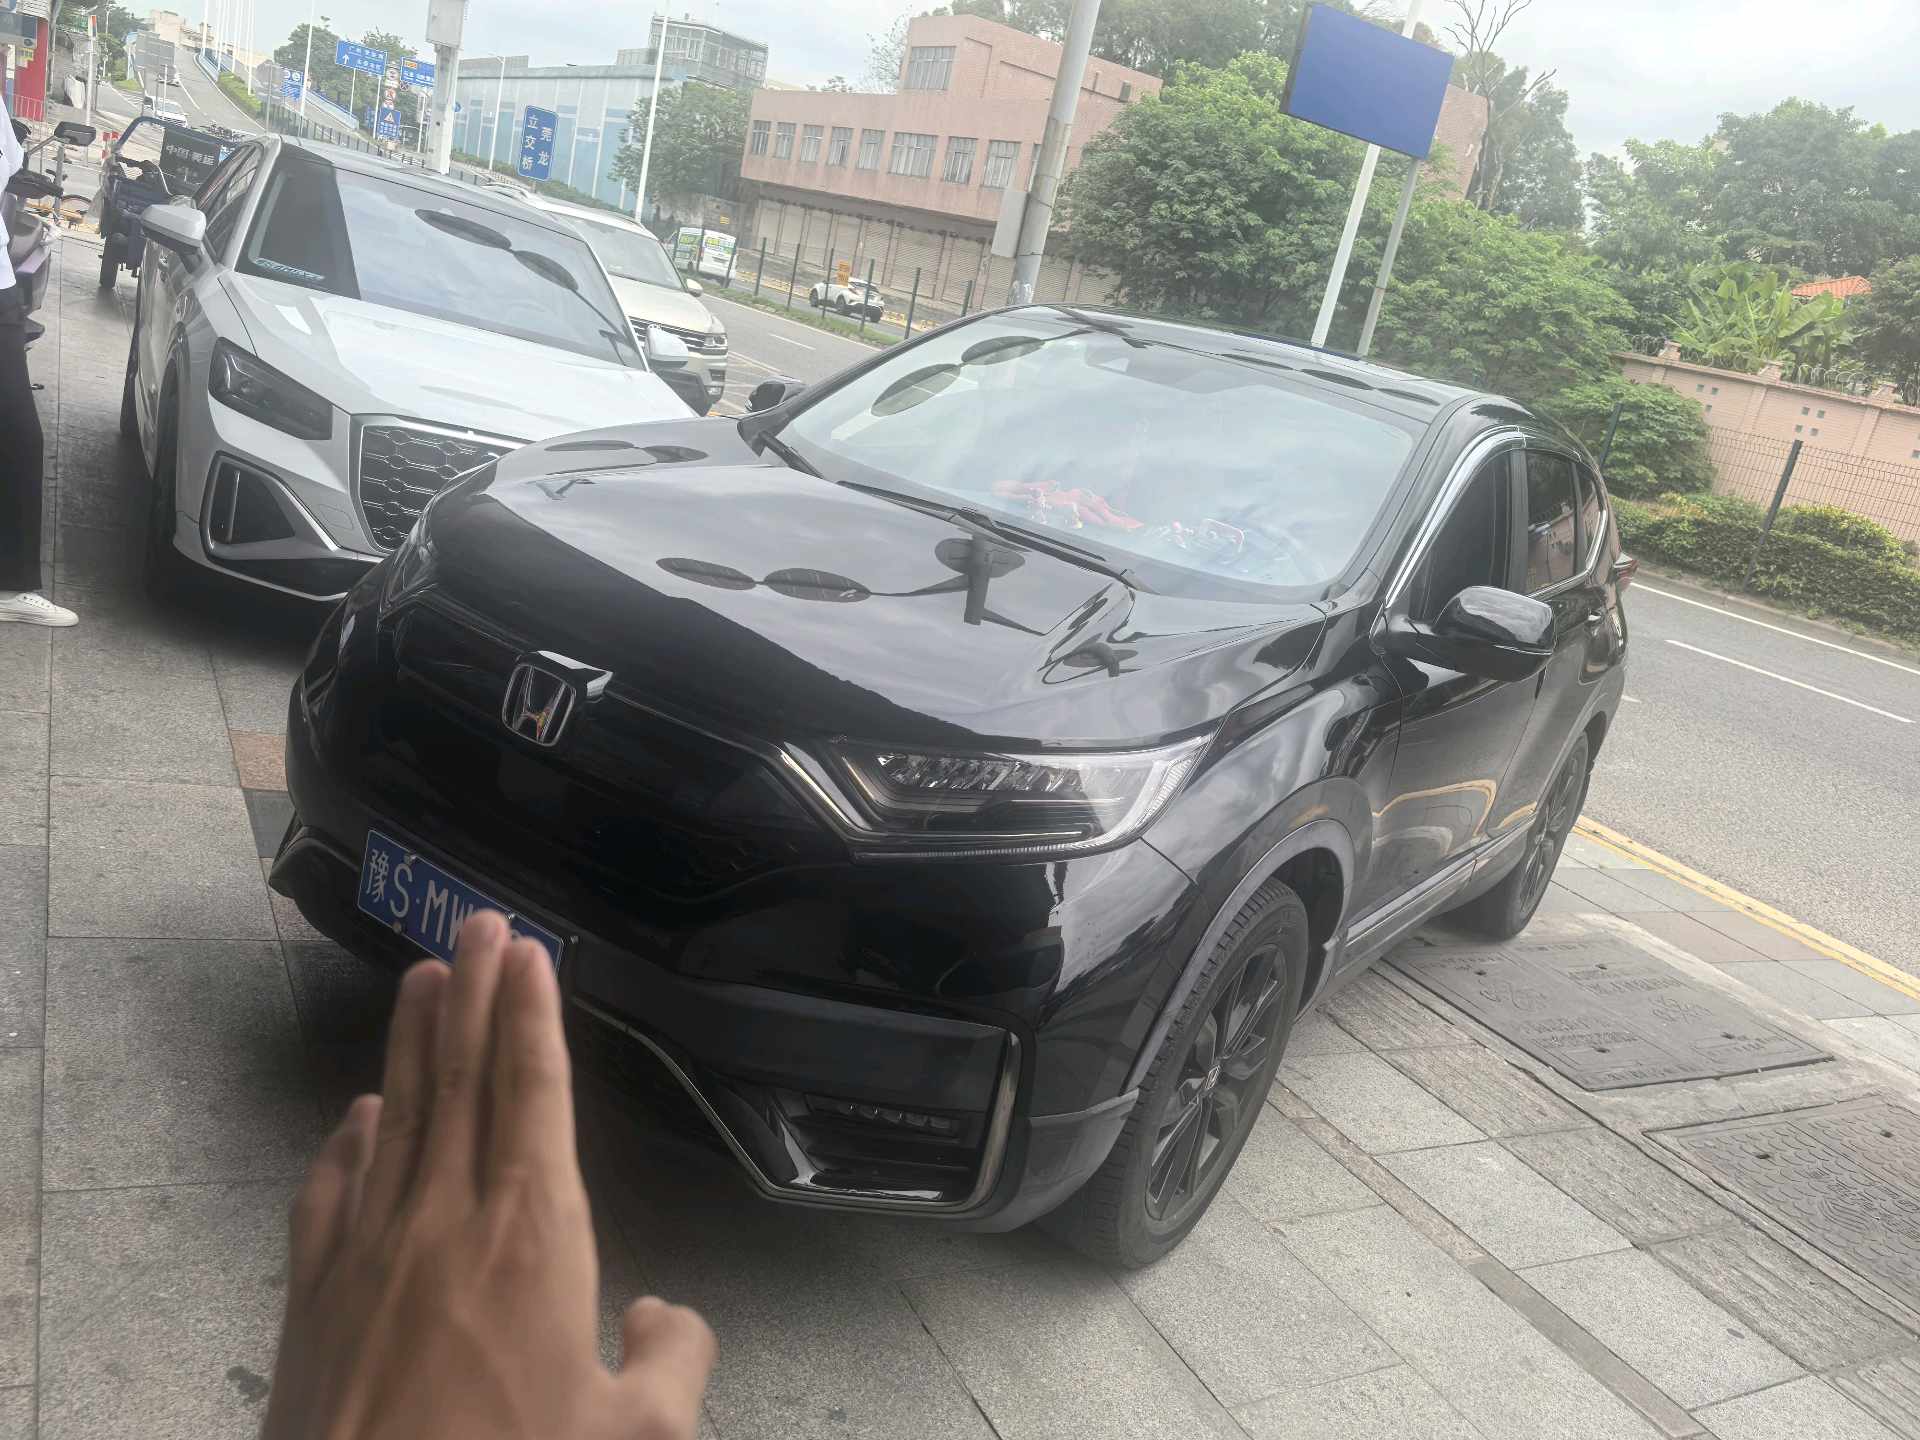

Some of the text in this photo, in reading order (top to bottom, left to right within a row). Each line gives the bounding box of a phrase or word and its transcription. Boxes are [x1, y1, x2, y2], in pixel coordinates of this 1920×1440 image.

[521, 114, 539, 171] 立交桥
[365, 848, 519, 953] 豫S·MW
